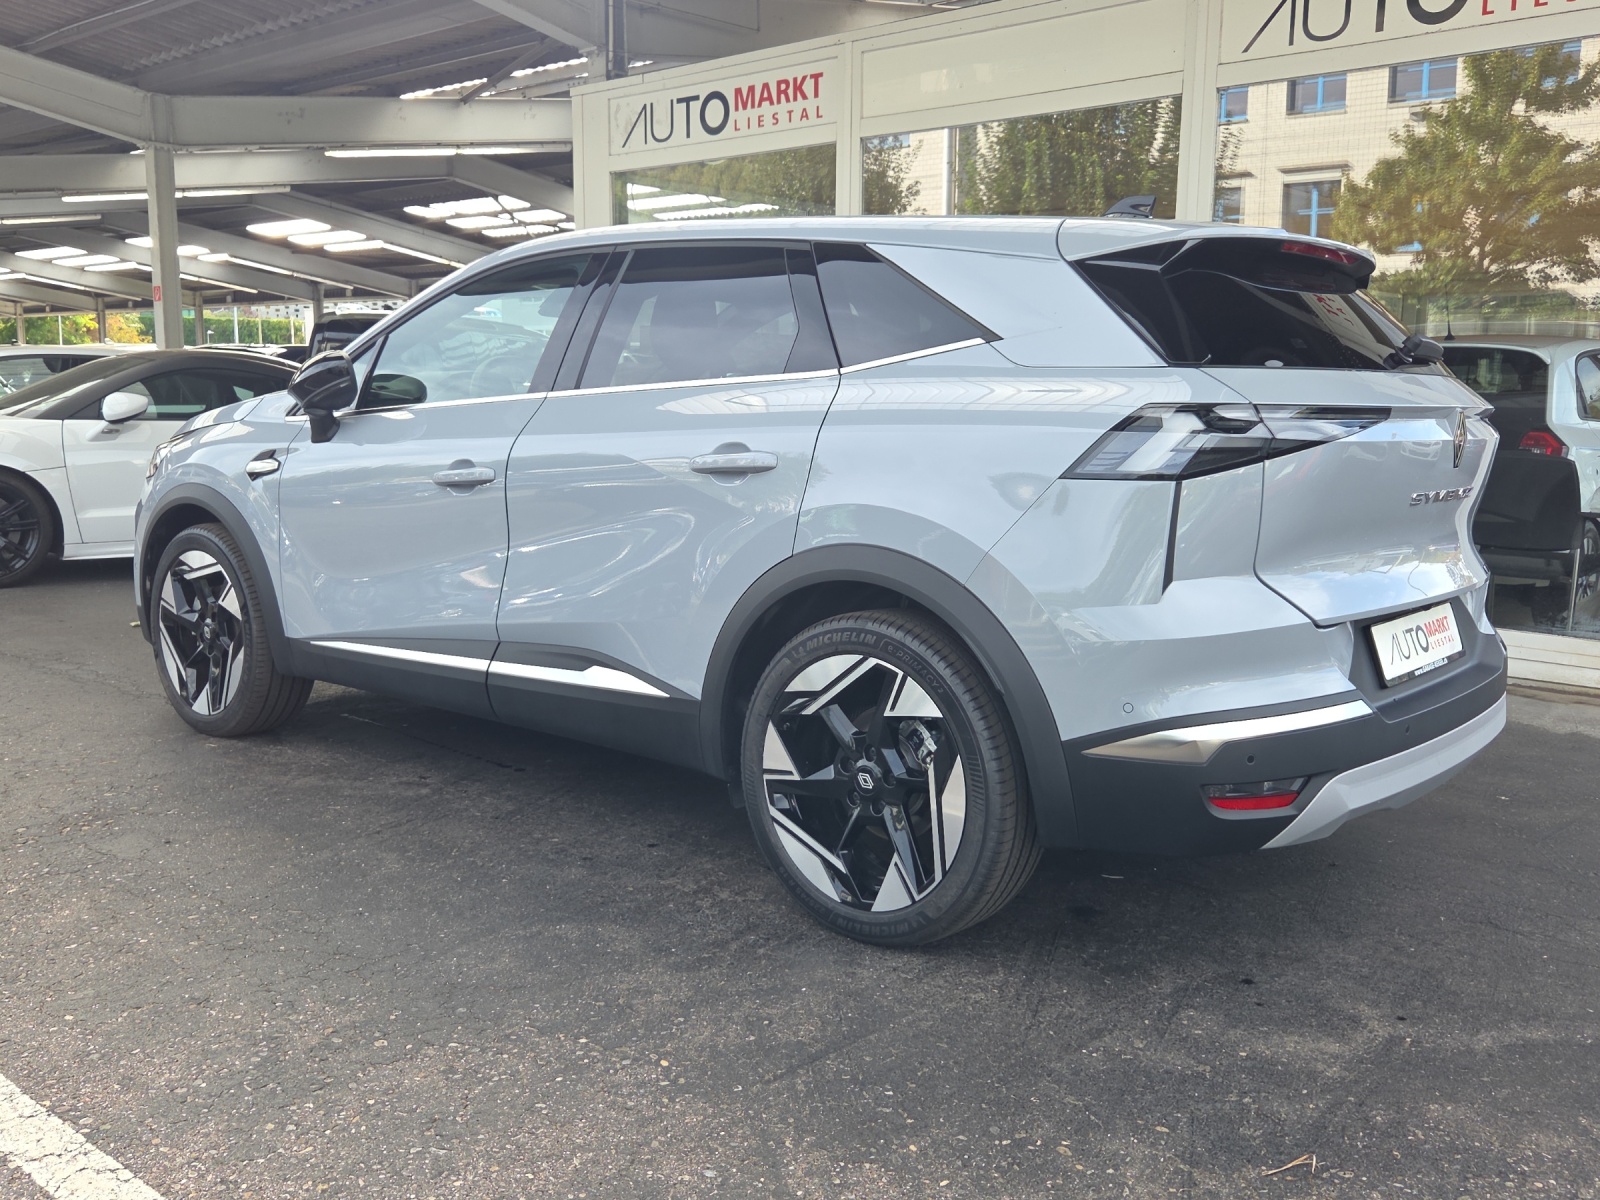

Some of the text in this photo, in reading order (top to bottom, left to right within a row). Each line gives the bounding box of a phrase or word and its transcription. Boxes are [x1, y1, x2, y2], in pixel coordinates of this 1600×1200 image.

[622, 72, 823, 148] AUTO MARKT
[734, 106, 823, 132] LIESTAL
[806, 631, 877, 650] MICHELIN
[1391, 615, 1451, 666] AUTO MARKT
[1430, 634, 1455, 650] LIESTAL
